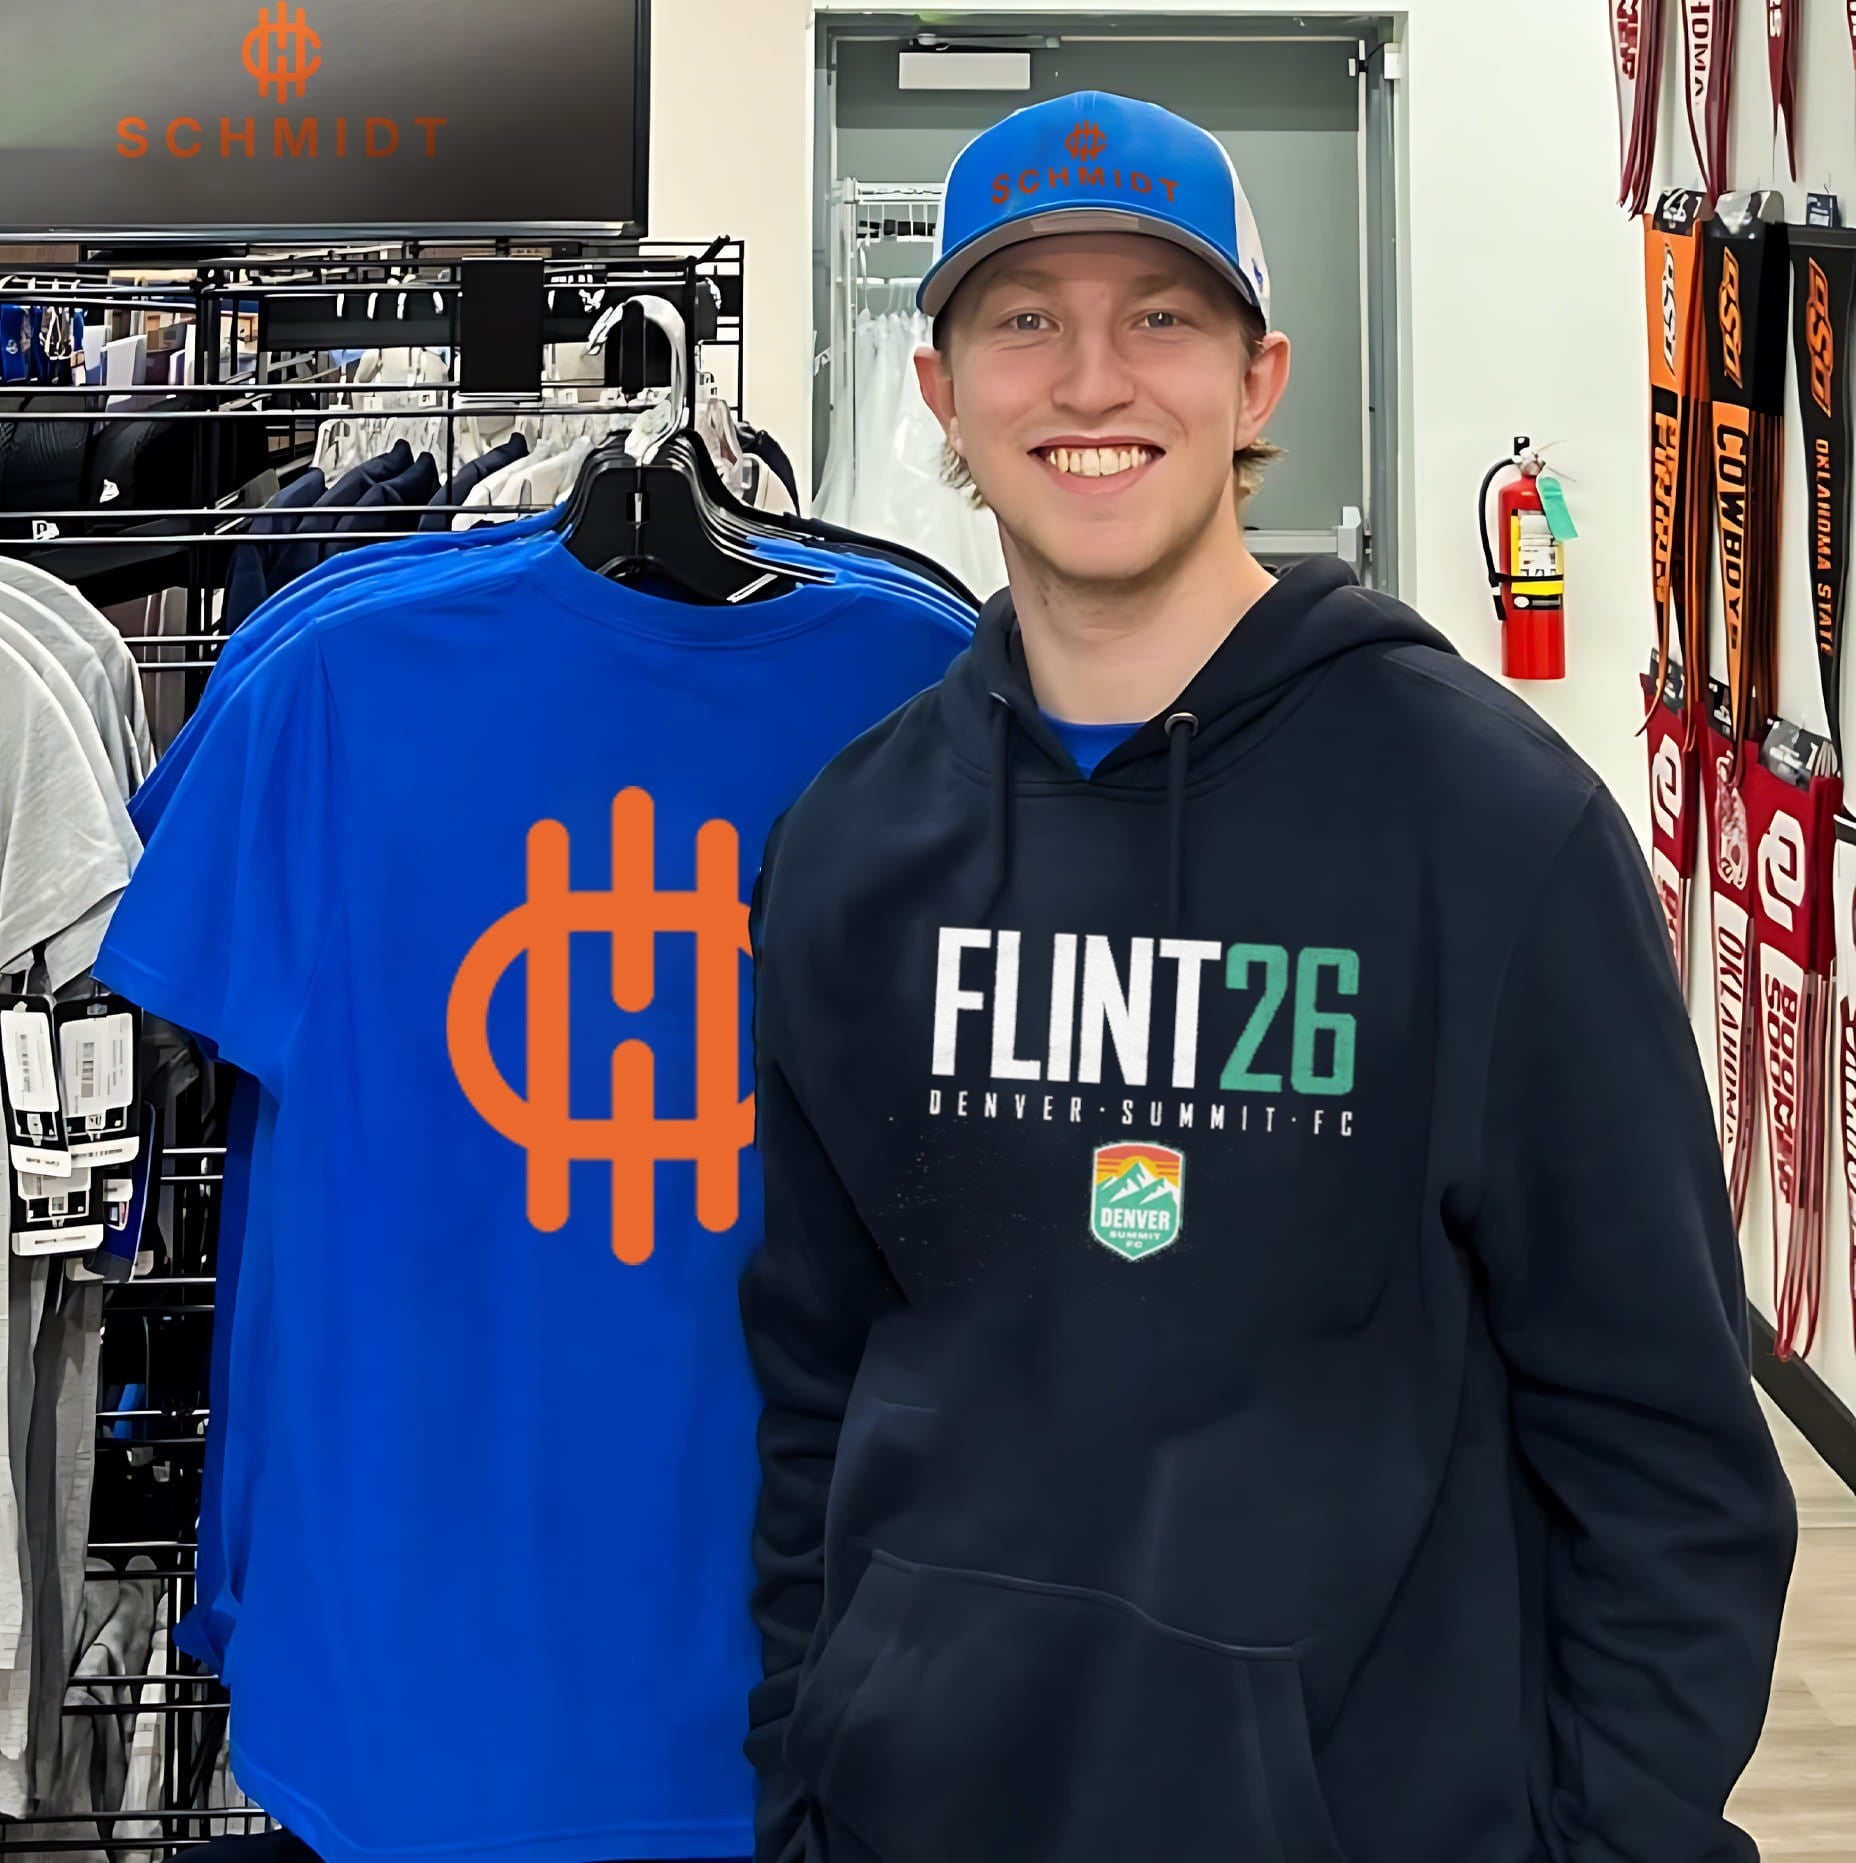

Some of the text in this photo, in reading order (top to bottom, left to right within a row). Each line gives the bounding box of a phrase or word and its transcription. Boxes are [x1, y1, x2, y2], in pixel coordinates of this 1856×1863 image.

[115, 116, 446, 158] SCHMIDT
[990, 167, 1180, 205] SCHMIDT
[1815, 438, 1832, 570] OKLAHOMA
[931, 927, 1360, 1095] FLINT26
[1100, 1207, 1171, 1231] DENVER
[1109, 1230, 1162, 1240] SUMMIT
[1125, 1240, 1143, 1249] FC
